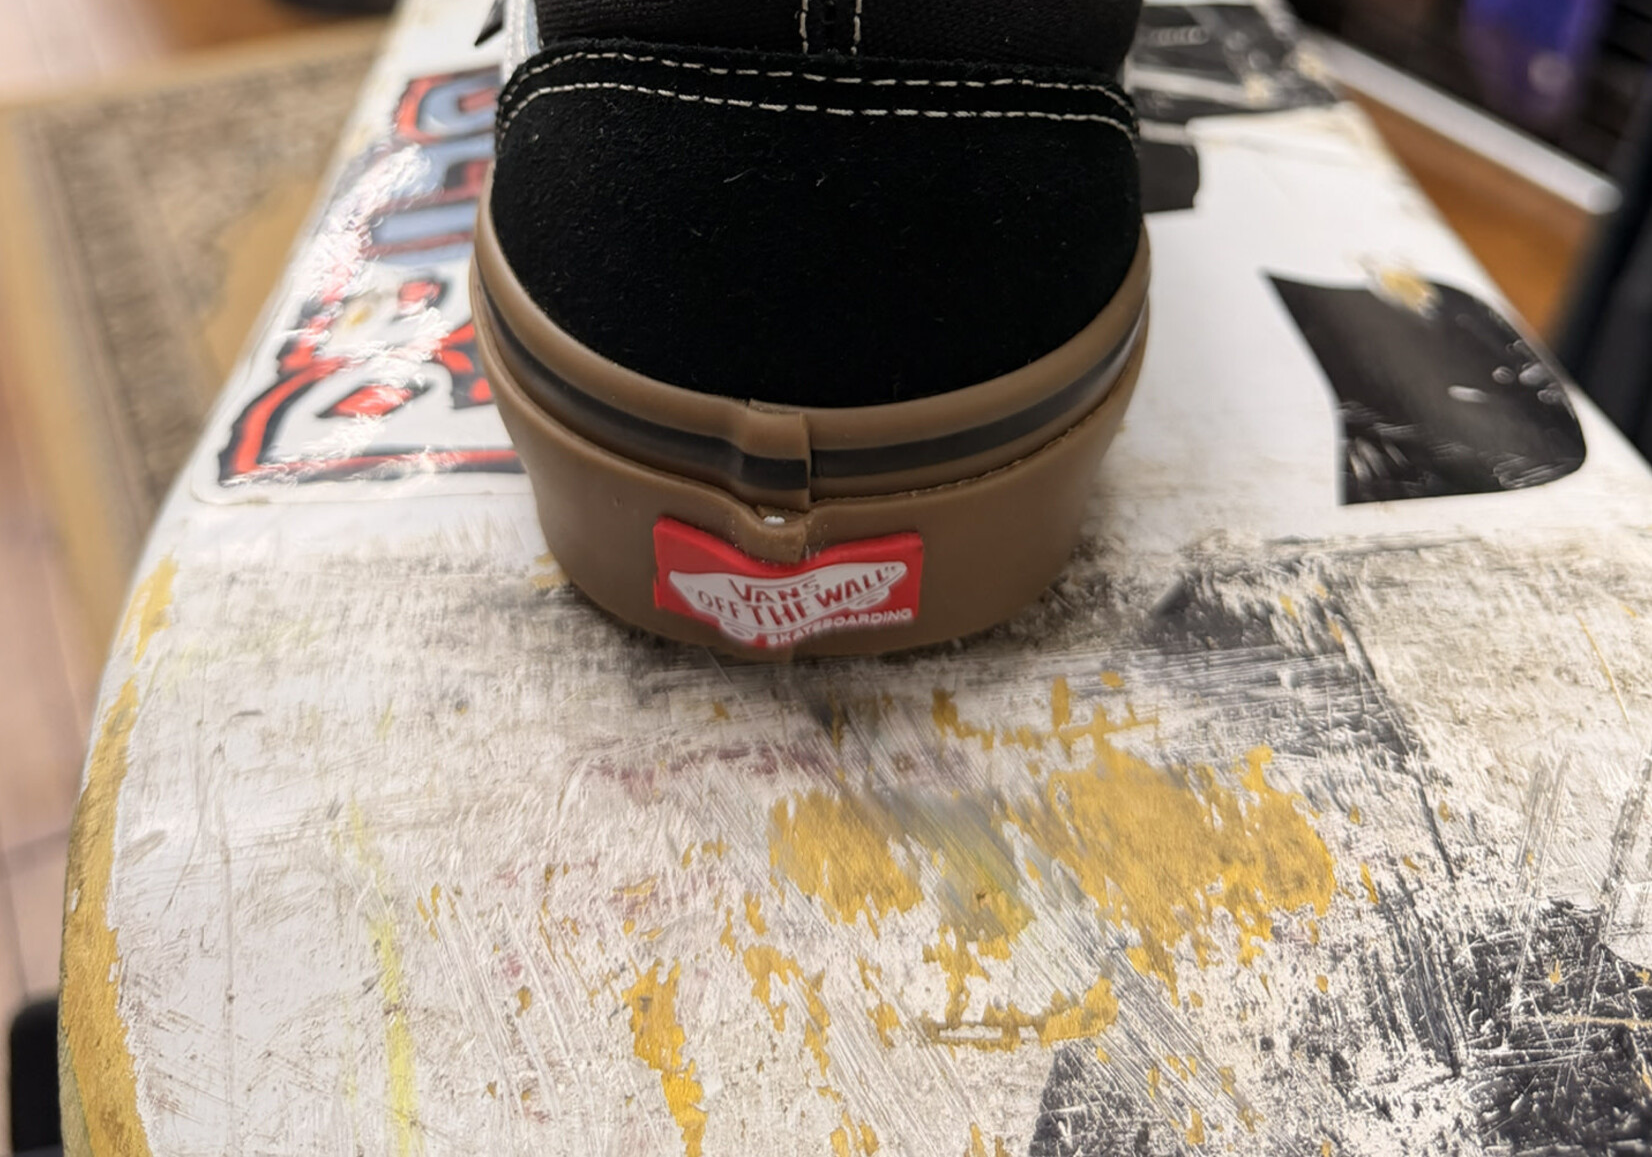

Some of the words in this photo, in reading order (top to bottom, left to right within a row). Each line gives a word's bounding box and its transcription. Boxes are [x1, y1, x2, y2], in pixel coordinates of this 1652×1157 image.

[728, 577, 820, 603] VANS
[746, 597, 816, 627] THE
[766, 607, 913, 645] SKATEBOARDING
